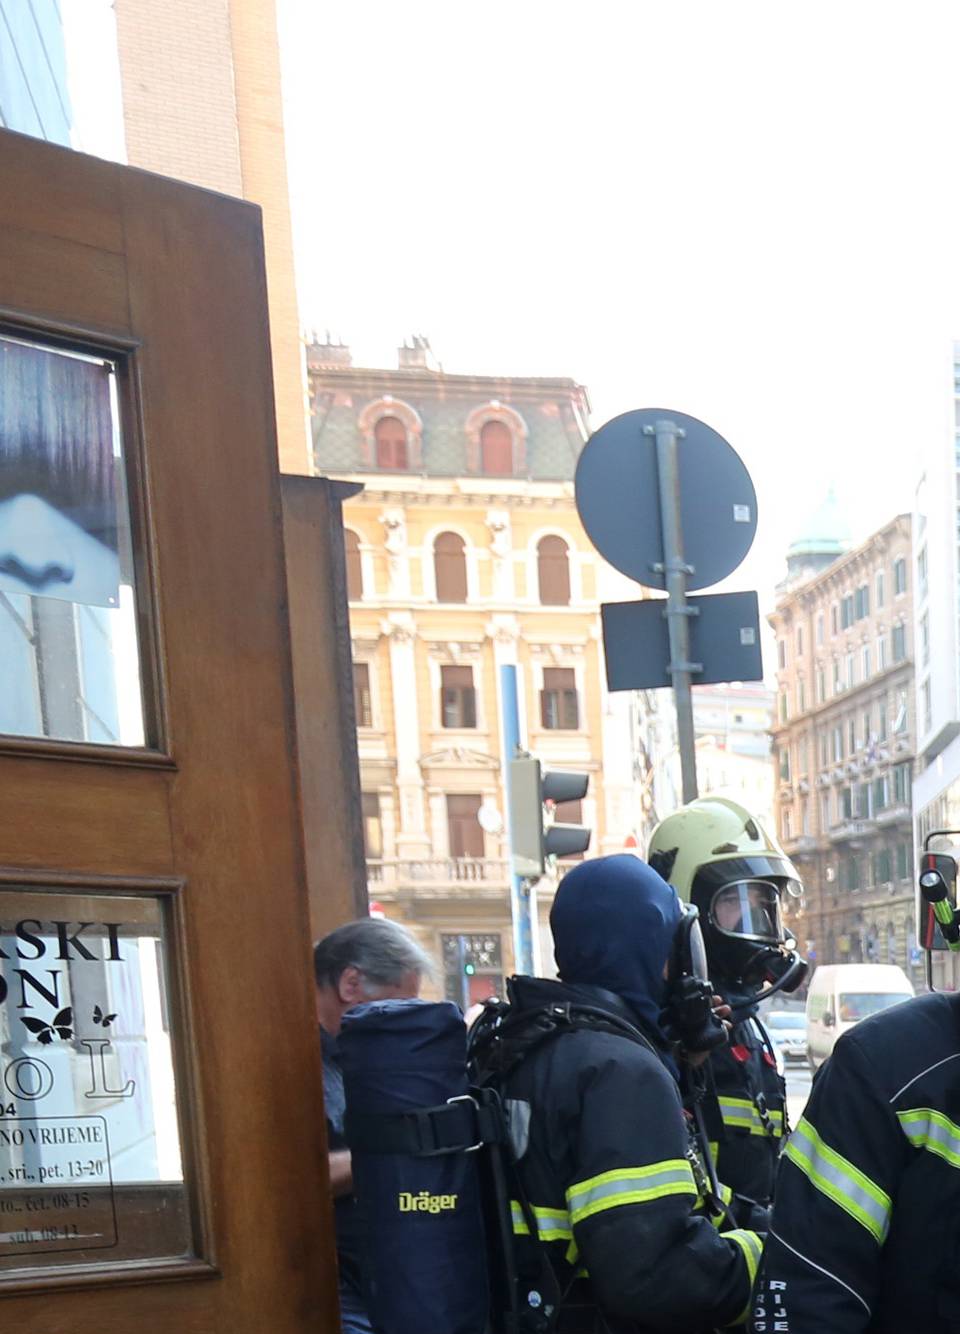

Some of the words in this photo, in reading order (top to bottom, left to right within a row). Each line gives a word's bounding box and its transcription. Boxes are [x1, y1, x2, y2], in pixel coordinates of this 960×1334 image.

[0, 919, 126, 961] SKI
[28, 1126, 103, 1145] VRIJEME
[68, 1160, 104, 1178] 13-20
[399, 1191, 458, 1214] Dräger
